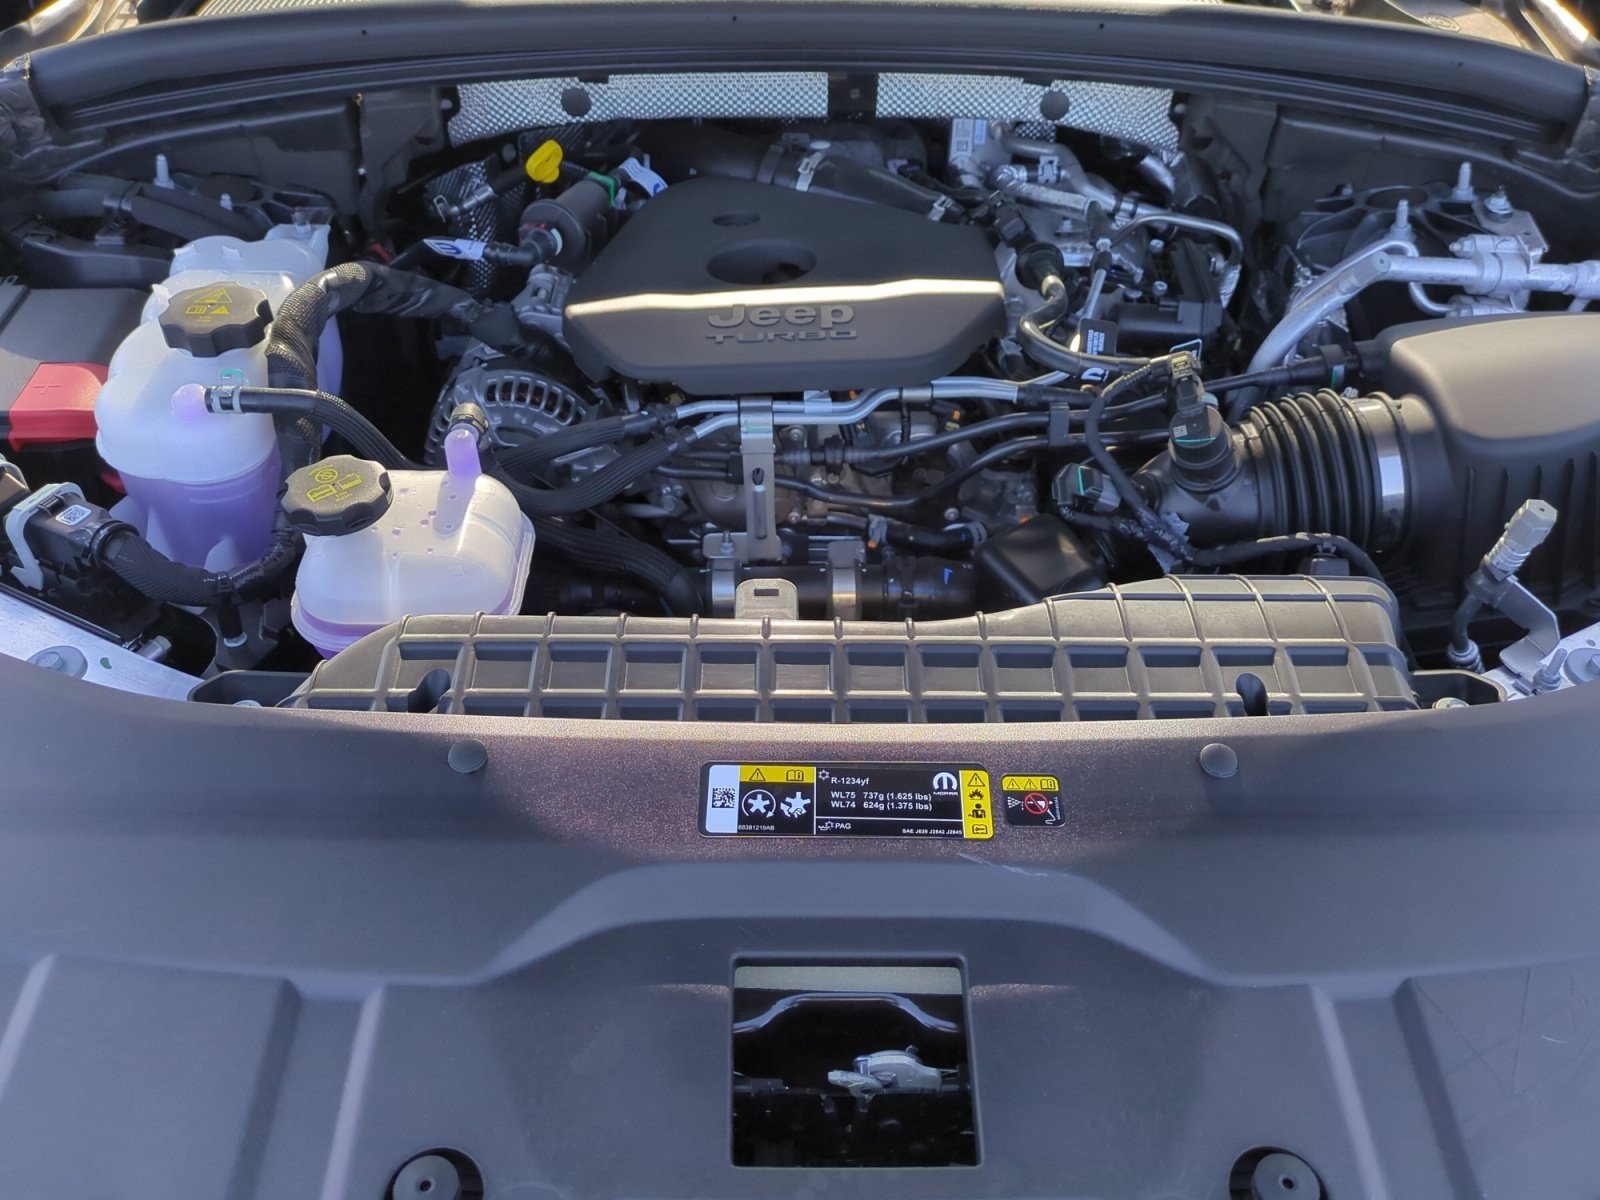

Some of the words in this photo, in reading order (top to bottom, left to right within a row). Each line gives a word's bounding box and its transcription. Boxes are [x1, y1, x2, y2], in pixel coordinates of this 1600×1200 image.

[708, 304, 854, 329] Jeep
[705, 330, 857, 344] TURBO
[831, 777, 869, 786] R-1234yf
[830, 791, 856, 799] WL75
[863, 792, 884, 801] 737g
[886, 792, 913, 801] (1.625
[915, 793, 932, 802] lbs)
[863, 802, 884, 811] 624g
[886, 802, 913, 811] (1.375
[915, 803, 932, 812] lbs)
